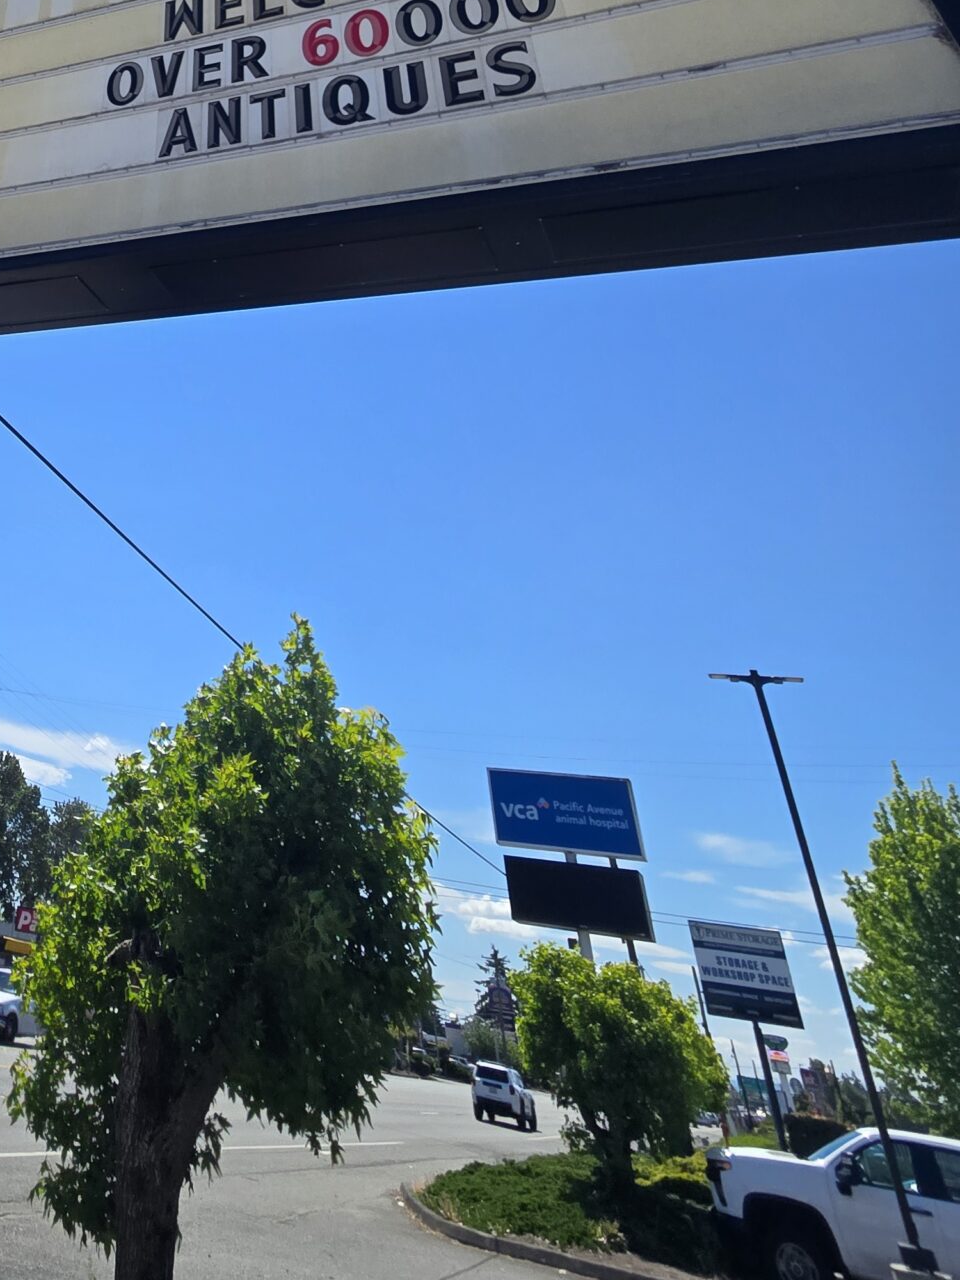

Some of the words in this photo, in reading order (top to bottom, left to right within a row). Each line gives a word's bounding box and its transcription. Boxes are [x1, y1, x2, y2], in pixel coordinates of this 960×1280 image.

[106, 35, 270, 107] OVER
[158, 41, 537, 158] ANTIQUES
[500, 802, 539, 821] vca
[553, 800, 585, 813] Pacific
[587, 804, 624, 816] Avenue
[555, 814, 586, 826] animal
[589, 816, 629, 830] hospital
[18, 910, 38, 932] Pa
[715, 955, 759, 972] STORAGE
[761, 962, 769, 972] &
[701, 966, 756, 983] WORKSHOP
[757, 973, 791, 988] SPACE
